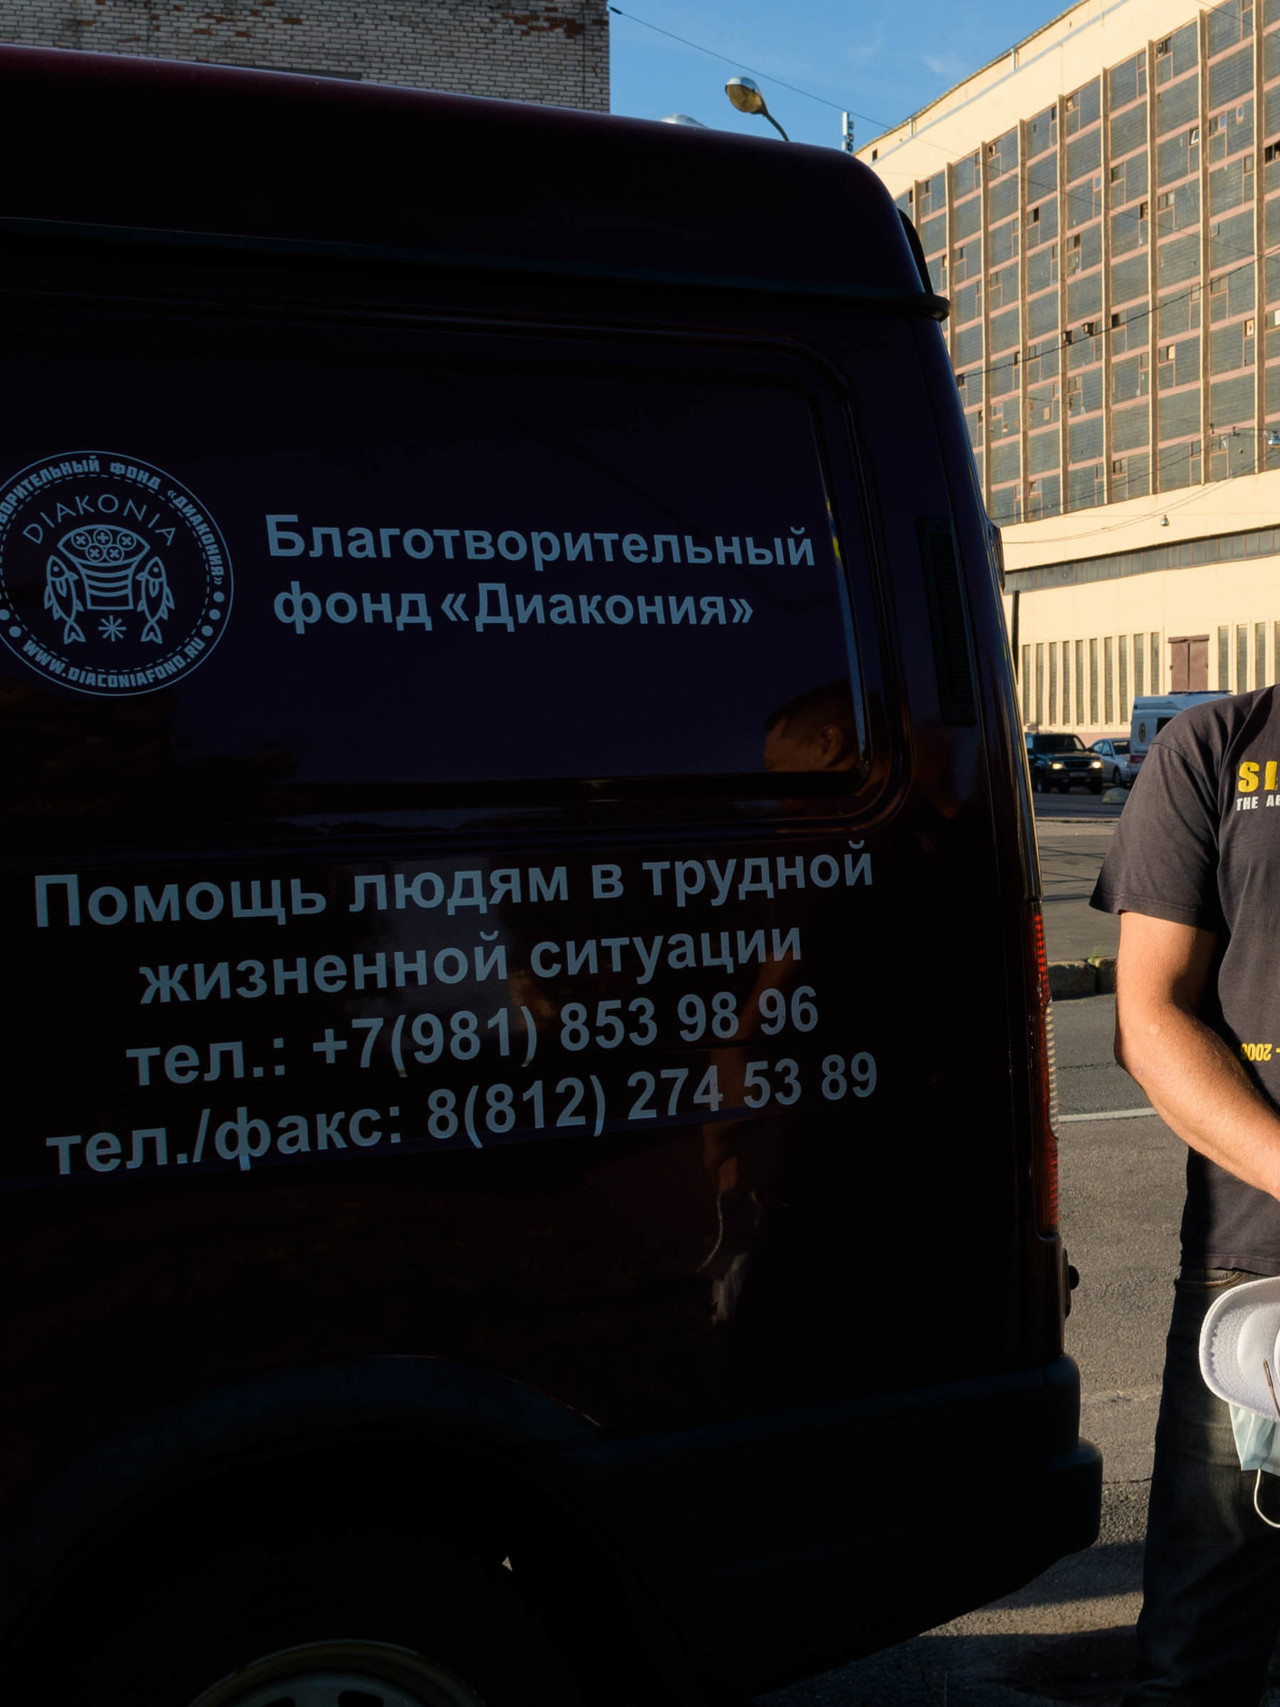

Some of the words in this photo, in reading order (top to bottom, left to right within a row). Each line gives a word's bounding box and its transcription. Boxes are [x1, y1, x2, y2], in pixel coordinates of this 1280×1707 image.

[0, 456, 100, 531] ВОРИТЕЛЬНЫЙ
[109, 461, 162, 491] ФОНД
[167, 489, 226, 586] «ДИАКОНИЯ»
[22, 493, 177, 546] DIAKONIA
[265, 514, 815, 572] Благотворительный
[273, 580, 433, 635] фонд
[440, 582, 754, 633] «Диакония»
[1236, 796, 1259, 812] THE
[35, 874, 327, 926] Помощь
[349, 866, 569, 916] людям
[591, 864, 624, 899] в
[642, 840, 875, 908] трудной
[139, 930, 507, 1004] жизненной
[530, 926, 802, 985] ситуации
[127, 1036, 286, 1086] тел.:
[312, 1005, 538, 1076] +7(981)
[560, 997, 658, 1052] 853
[677, 991, 739, 1041] 98
[757, 985, 819, 1035] 96
[46, 1106, 402, 1175] тел./факс:
[428, 1075, 606, 1149] 8(812)
[627, 1066, 723, 1121] 274
[743, 1059, 801, 1109] 53
[821, 1052, 878, 1101] 89
